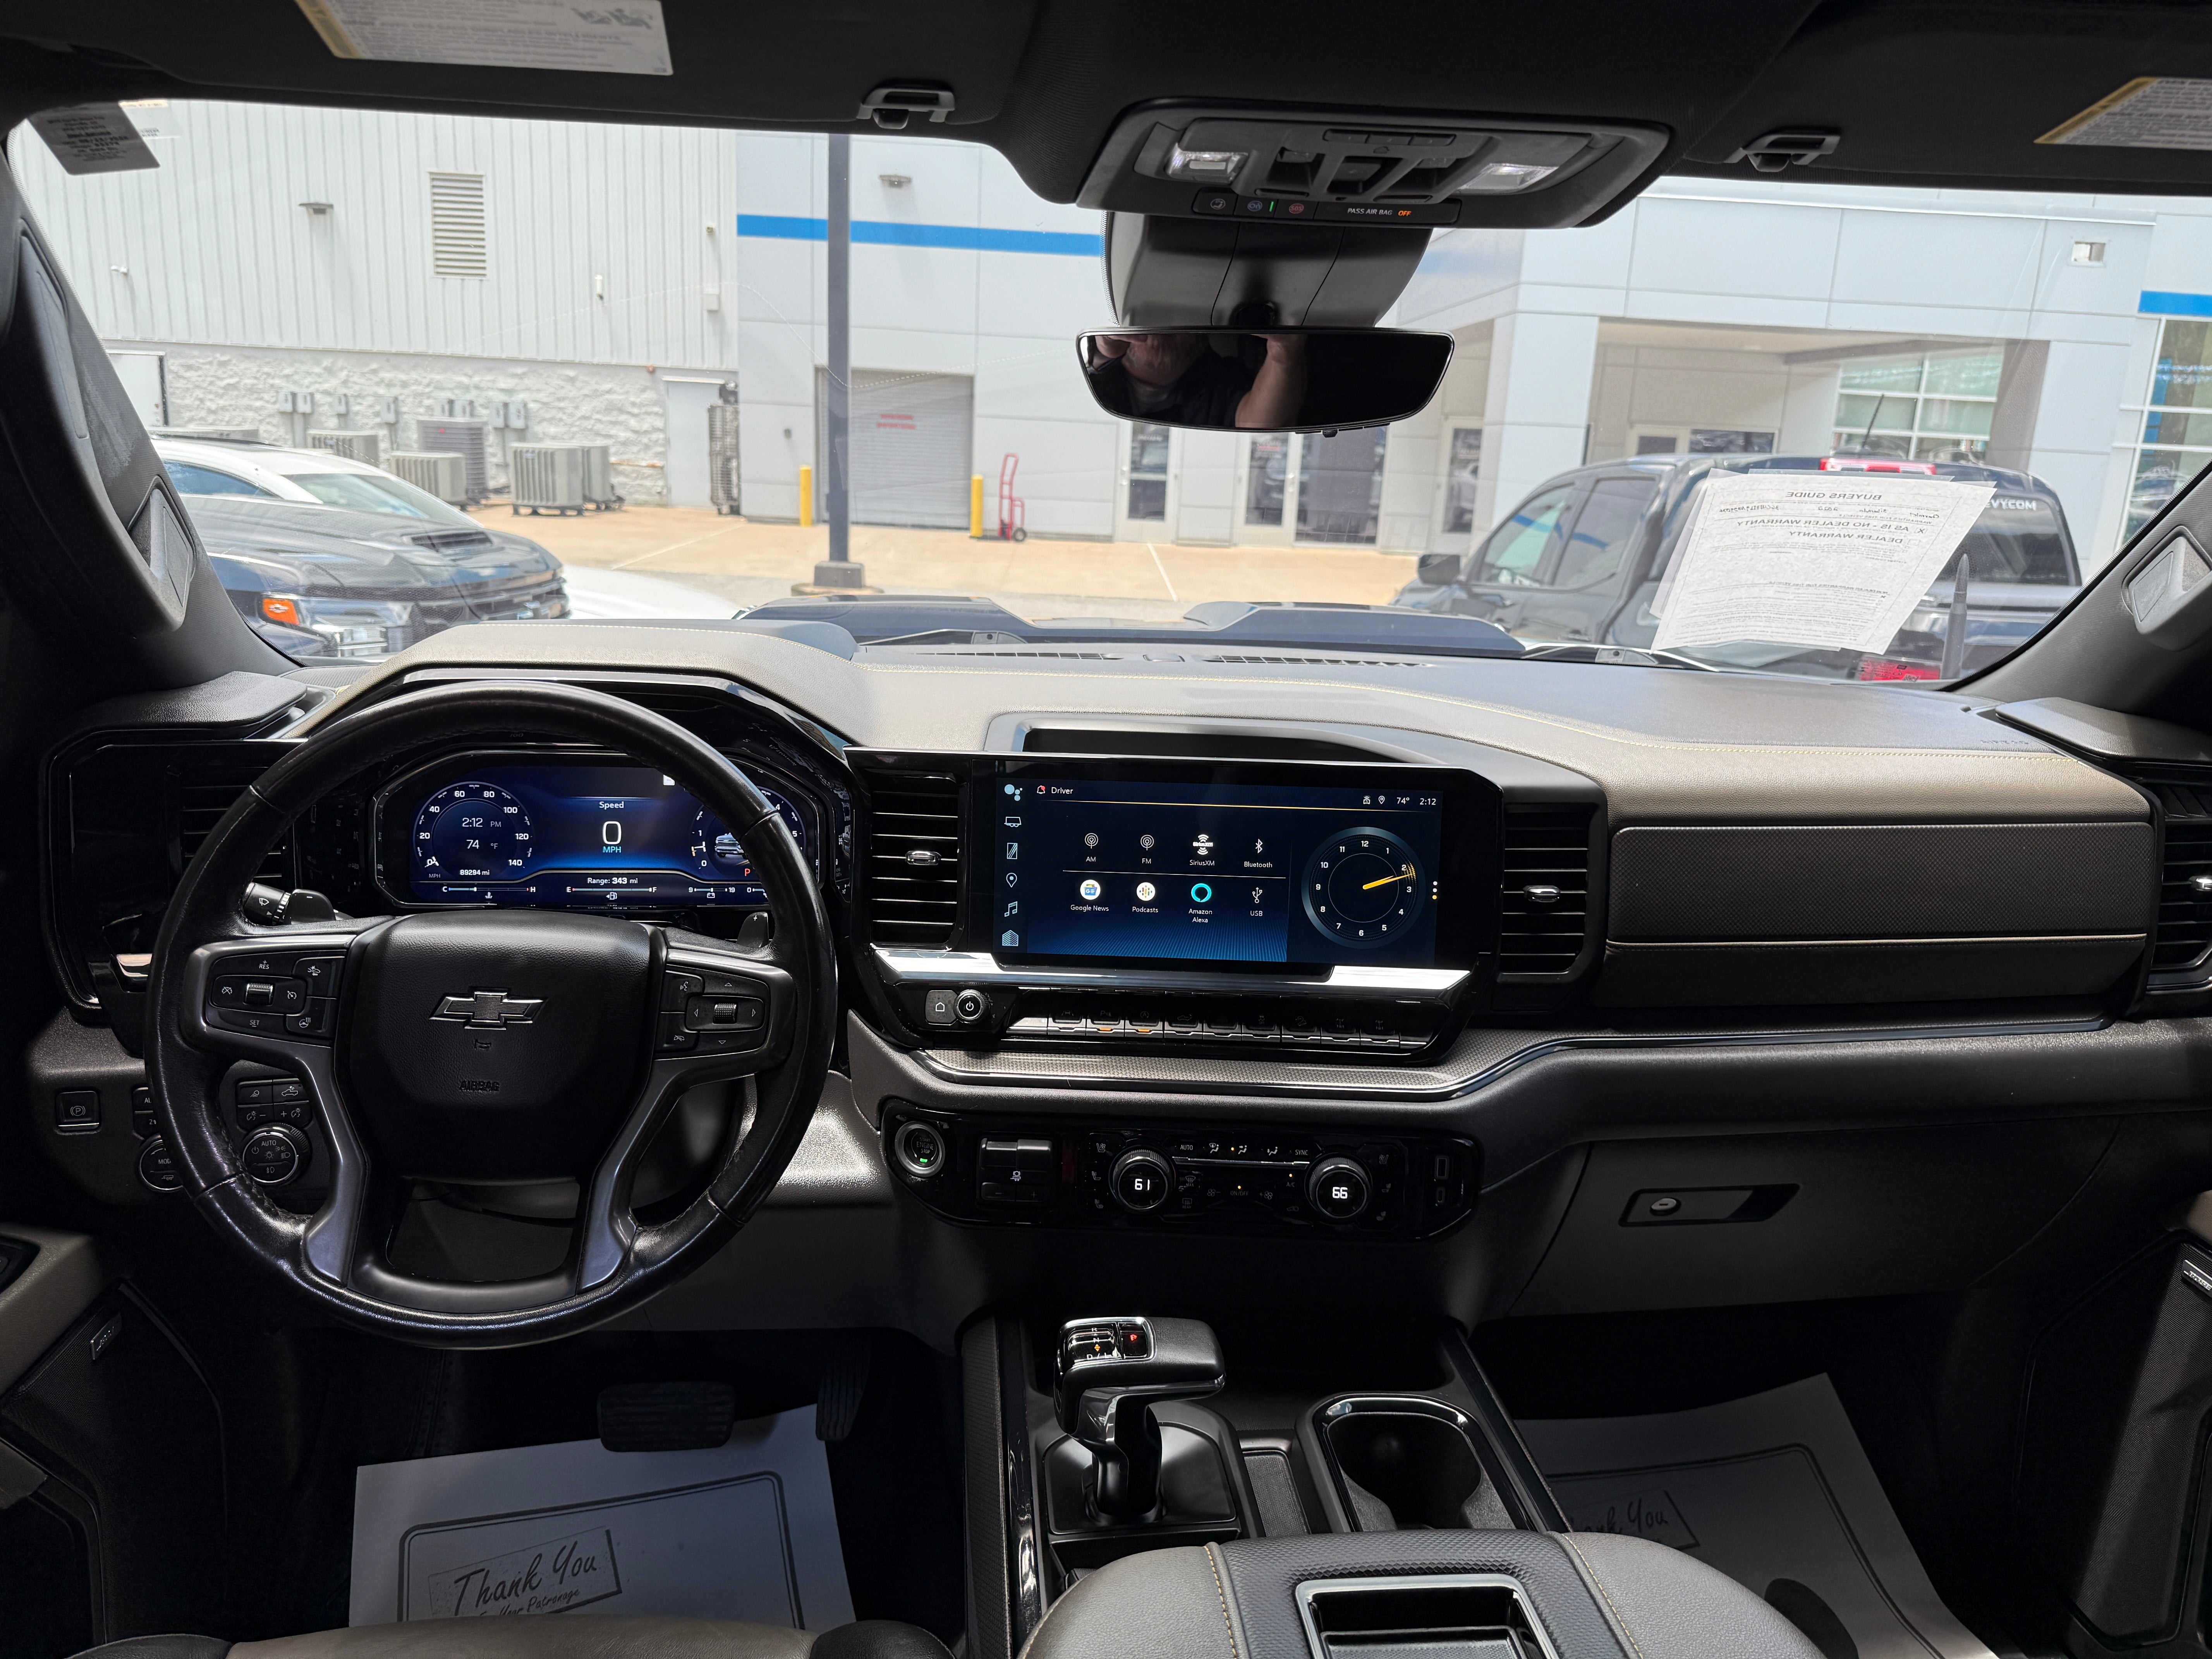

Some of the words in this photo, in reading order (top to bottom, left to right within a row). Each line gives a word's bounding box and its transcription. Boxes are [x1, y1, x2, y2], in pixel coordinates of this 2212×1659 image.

[1051, 787, 1073, 795] Driver
[599, 801, 624, 810] Speed
[462, 817, 483, 828] 2:12
[602, 821, 622, 845] 0
[466, 840, 480, 849] 74
[745, 868, 750, 876] P
[587, 878, 611, 886] Range:
[459, 1080, 500, 1092] AIRBAG
[916, 1141, 934, 1150] ENGINE
[1134, 1179, 1150, 1190] 61
[1332, 1187, 1348, 1199] 66
[1627, 1498, 1668, 1534] You
[453, 1553, 543, 1616] Thank
[552, 1540, 597, 1585] You
[527, 1589, 580, 1613] Patronage
